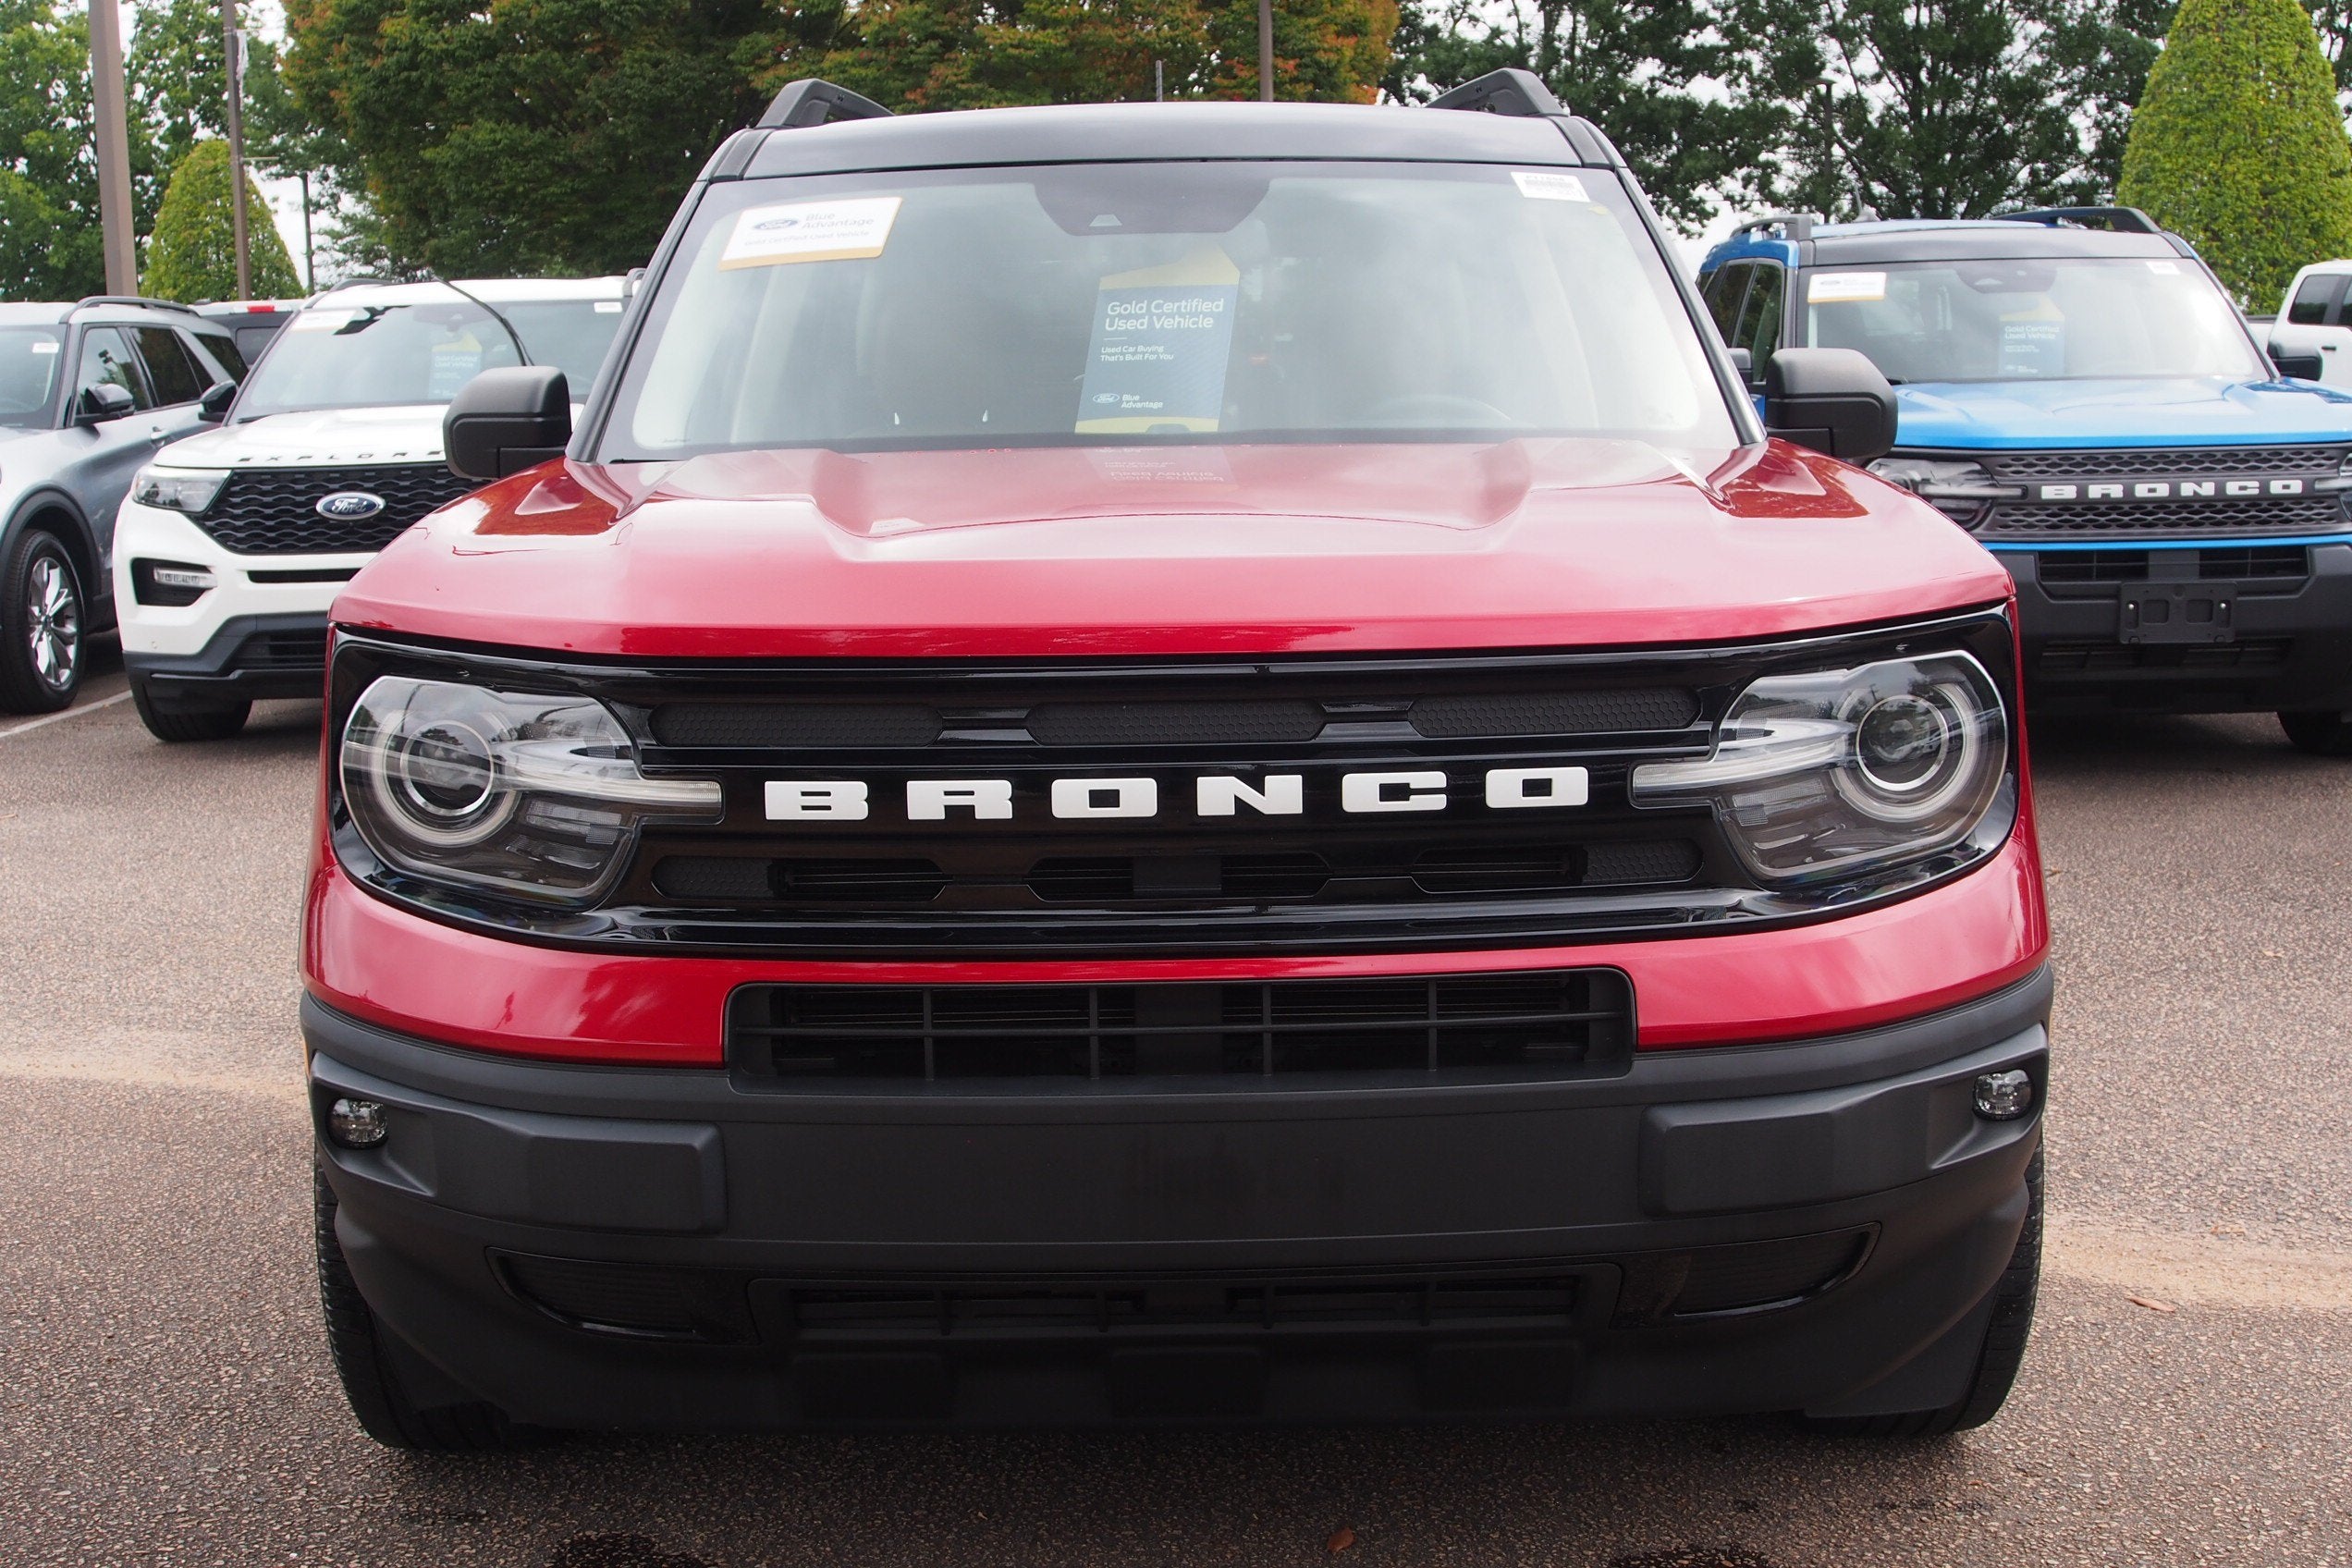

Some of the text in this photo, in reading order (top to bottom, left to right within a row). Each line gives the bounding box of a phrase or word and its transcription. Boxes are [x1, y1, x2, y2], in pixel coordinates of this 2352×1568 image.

[802, 217, 875, 229] Advantage
[806, 213, 836, 221] Blue
[837, 229, 870, 239] Vehicle
[1107, 298, 1225, 315] Gold Certified
[1105, 314, 1214, 331] Used Vehicle
[1137, 345, 1165, 353] Buying
[238, 450, 443, 462] EXPLORE
[2040, 479, 2303, 500] BRONCO
[764, 766, 1589, 821] BRONCO
